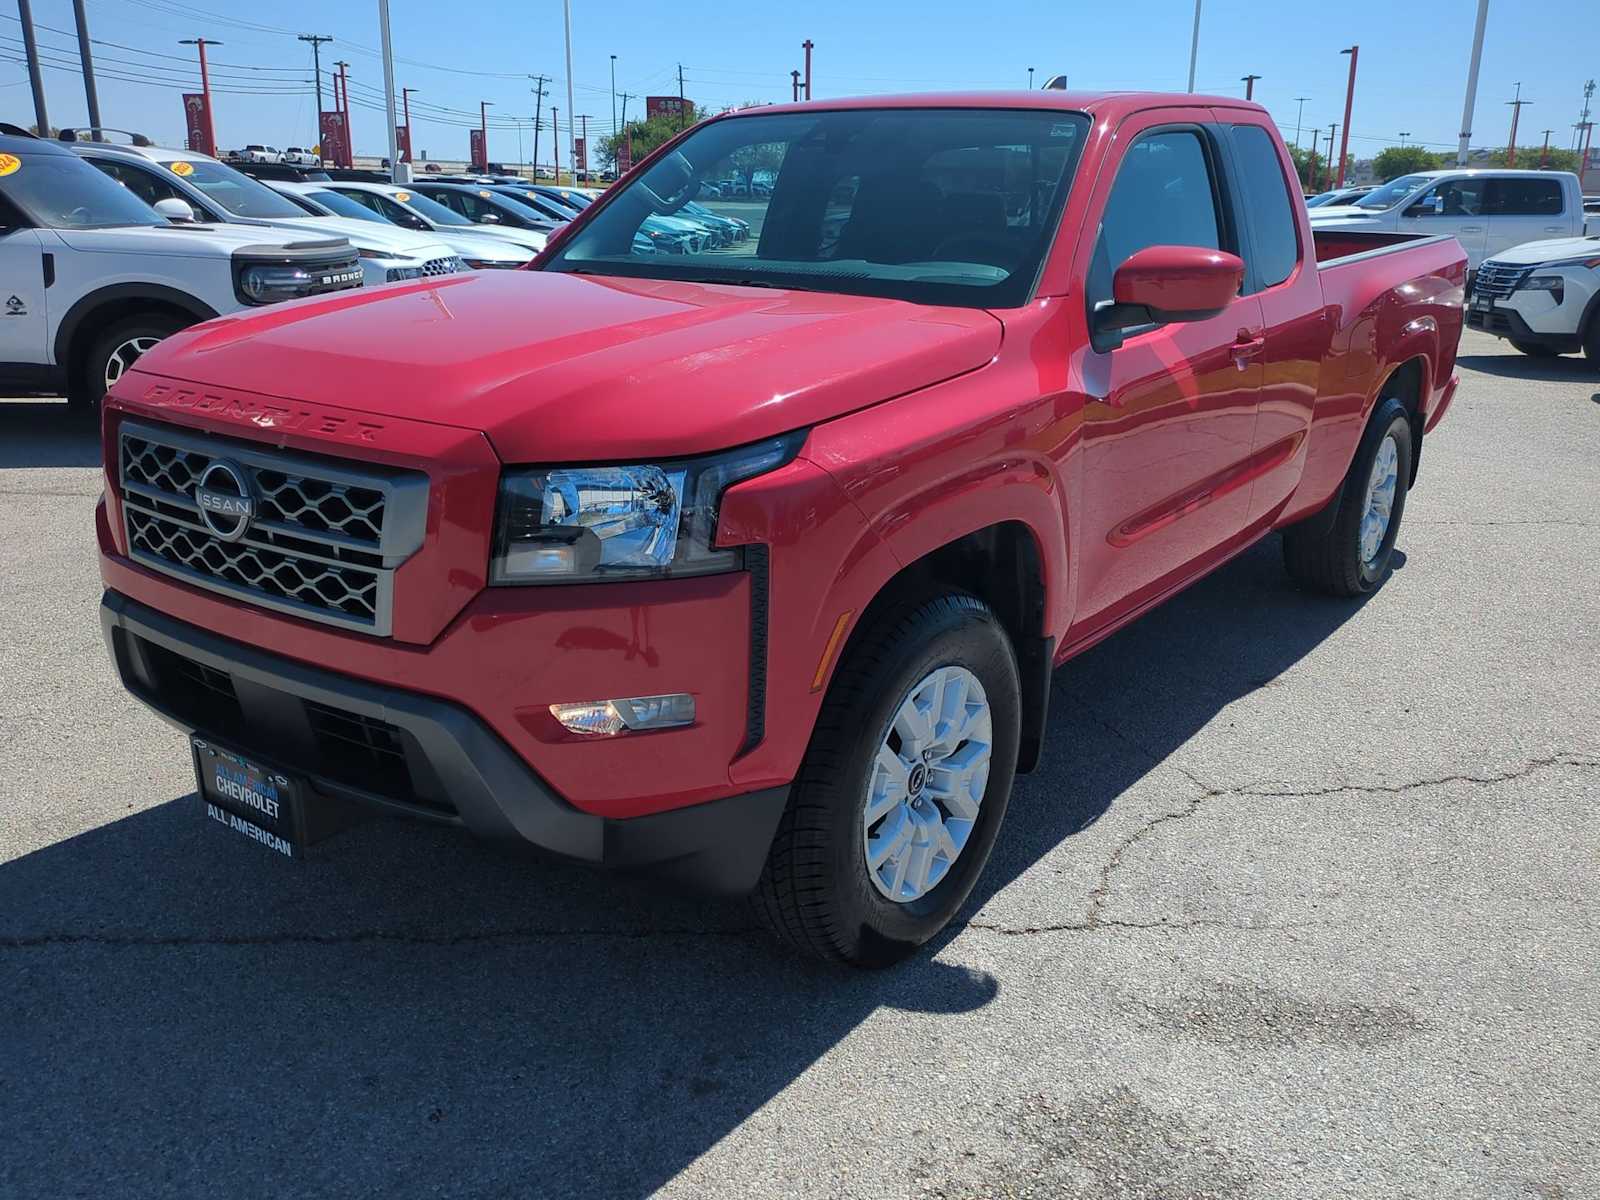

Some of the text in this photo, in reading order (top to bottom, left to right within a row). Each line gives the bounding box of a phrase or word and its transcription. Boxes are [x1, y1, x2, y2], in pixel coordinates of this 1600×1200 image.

[322, 271, 364, 284] BRONCO
[199, 492, 249, 513] ISSAN
[216, 775, 280, 819] CHEVROLET
[207, 804, 292, 857] ALL AMERICAN
